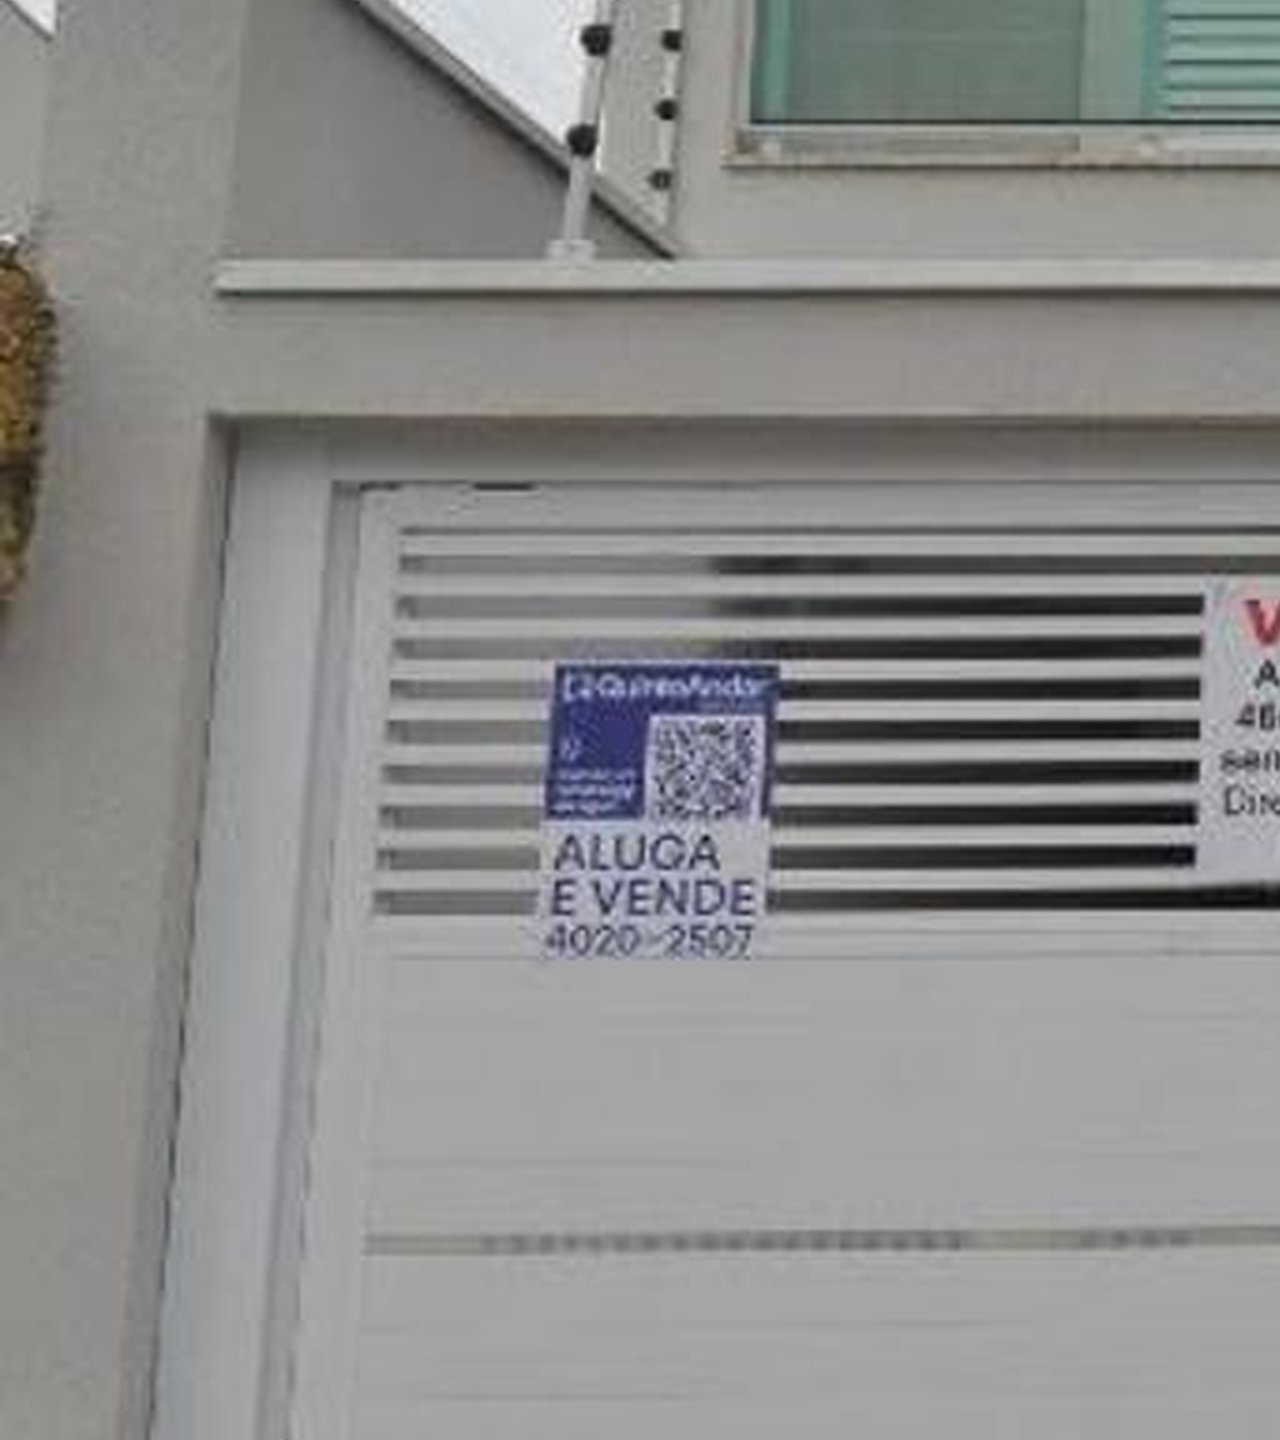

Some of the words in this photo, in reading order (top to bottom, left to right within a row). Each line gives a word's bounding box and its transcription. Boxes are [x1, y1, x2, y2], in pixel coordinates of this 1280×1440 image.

[554, 833, 721, 872] ALUGA
[550, 879, 578, 917] E
[592, 877, 756, 917] VENDE
